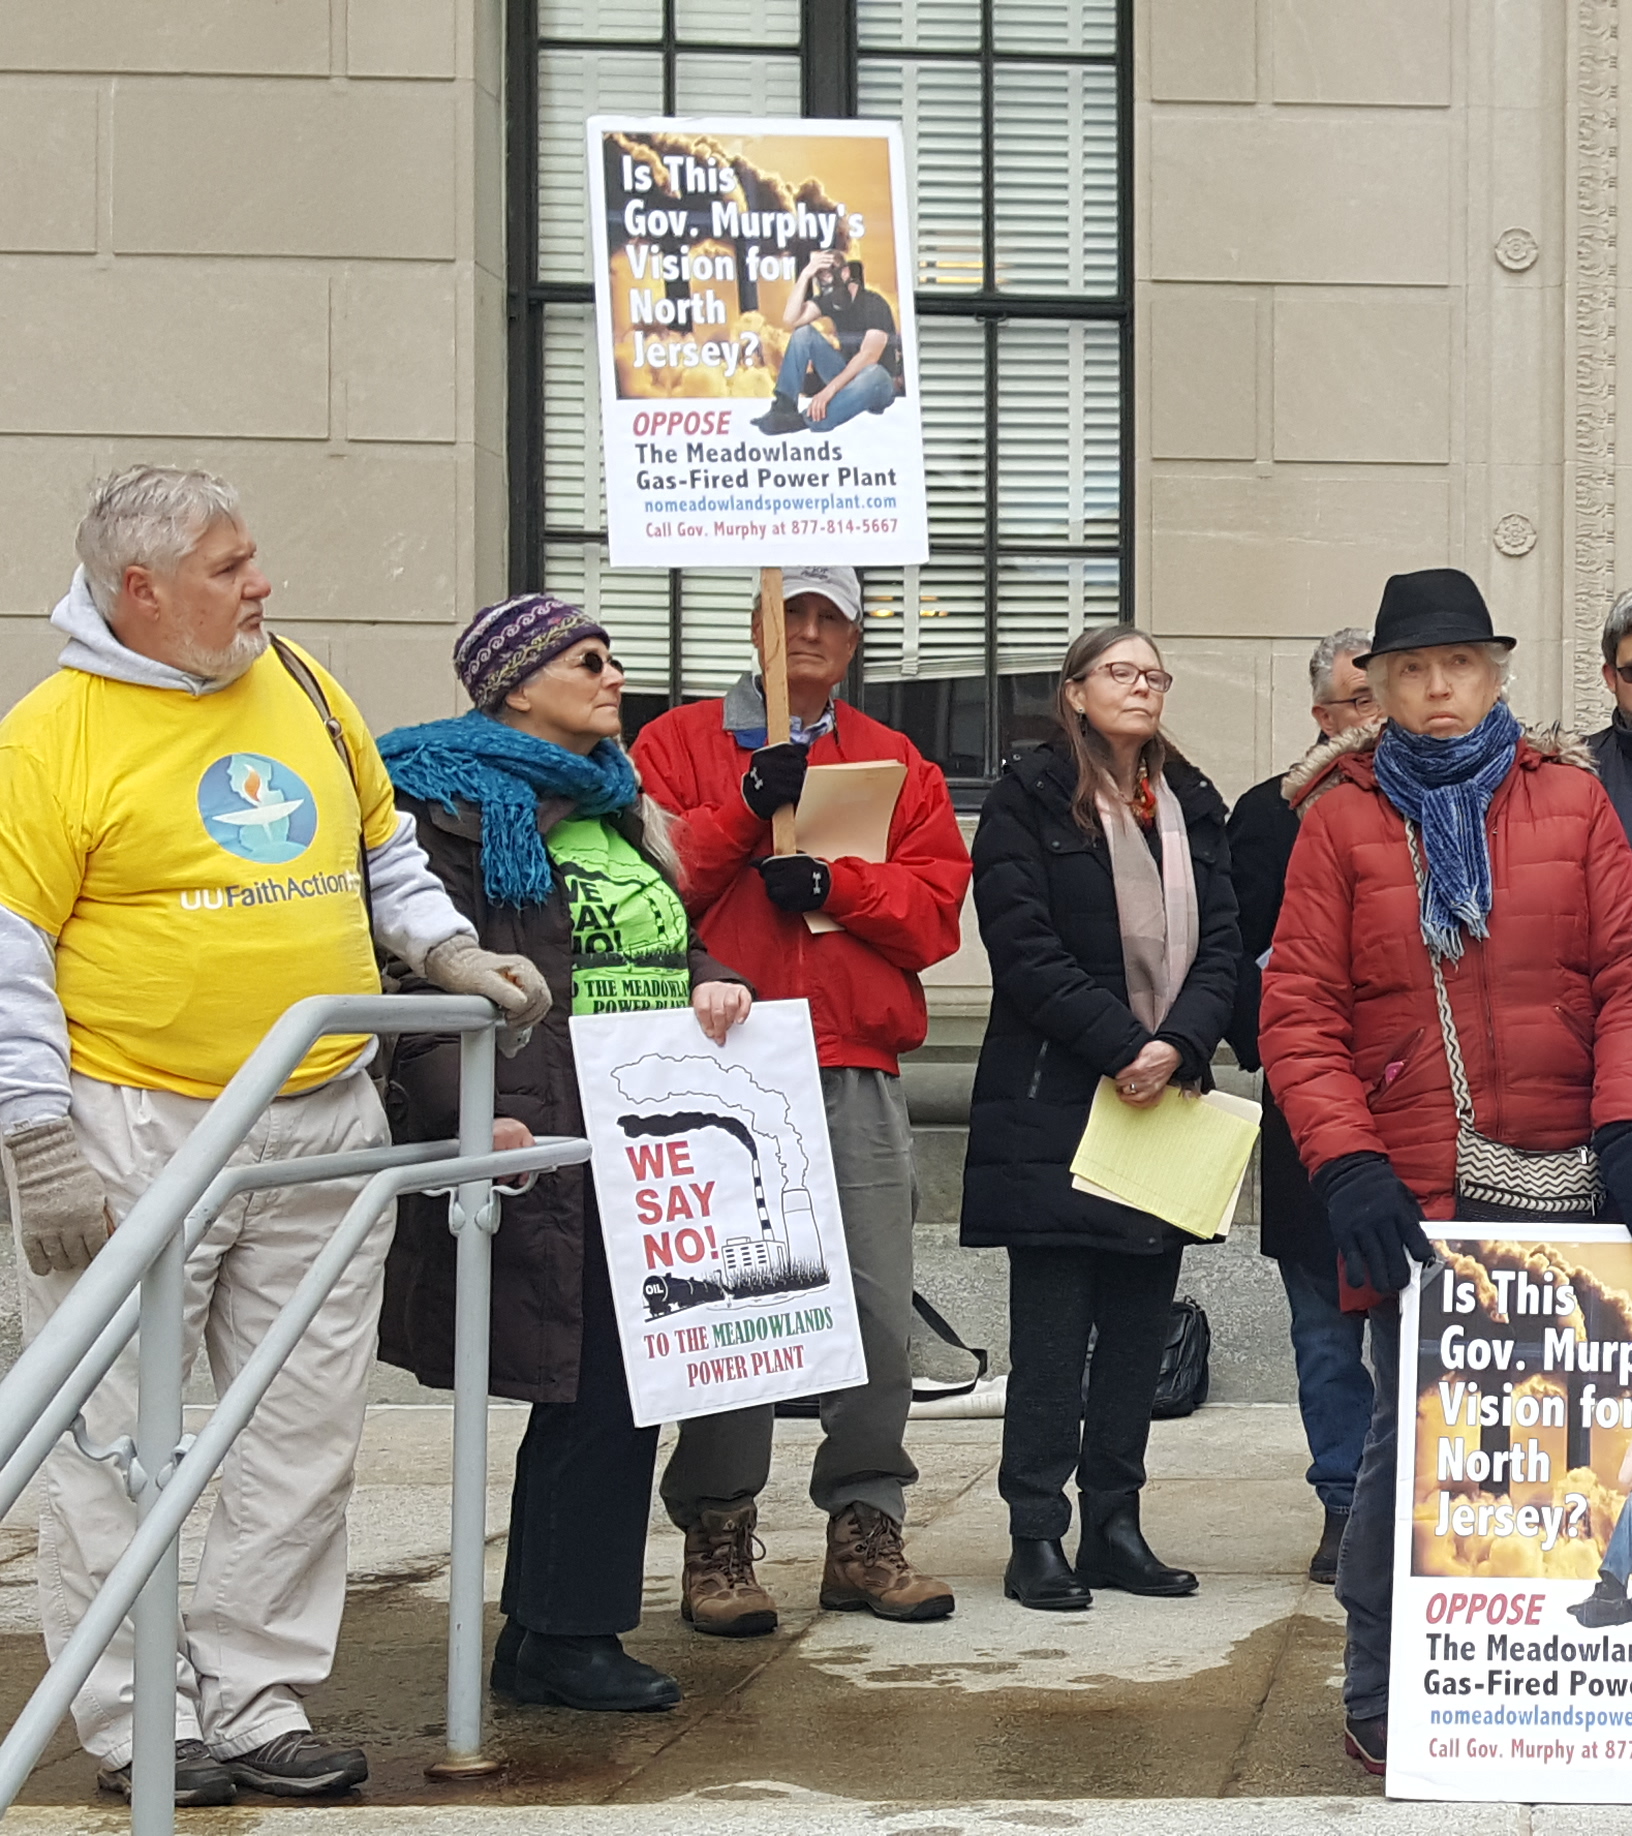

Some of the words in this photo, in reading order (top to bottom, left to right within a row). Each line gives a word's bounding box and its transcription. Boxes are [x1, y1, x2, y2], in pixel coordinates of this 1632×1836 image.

[621, 155, 652, 192] Is
[663, 155, 736, 194] This
[624, 199, 699, 238] Gov.
[711, 203, 865, 248] Murphy's
[626, 245, 735, 281] Vision
[746, 250, 796, 281] for
[629, 289, 726, 325] North
[633, 330, 759, 377] Jersey?
[633, 410, 732, 436] OPPOSE
[635, 443, 678, 464] The
[687, 440, 842, 463] Meadowlands
[636, 469, 748, 490] Gas-Fired
[758, 468, 830, 488] Power
[837, 467, 897, 486] Plant
[645, 494, 897, 515] nomeadowlandspowerplant.com
[645, 522, 672, 538] Call
[677, 521, 709, 537] Gov.
[714, 521, 767, 539] Murphy
[772, 523, 786, 535] at
[791, 518, 898, 535] 877-814-5667
[571, 904, 618, 932] AY
[584, 980, 617, 997] THE
[626, 1140, 695, 1182] WE
[637, 1181, 716, 1225] SAY
[643, 1224, 720, 1270] NO!
[645, 1284, 664, 1295] OIL
[1442, 1269, 1475, 1313] Is
[1491, 1270, 1576, 1317] This
[644, 1333, 670, 1359] TO
[675, 1326, 709, 1354] THE
[712, 1307, 833, 1348] MEADOWLANDS
[1440, 1327, 1526, 1371] Gov.
[687, 1356, 748, 1387] POWER
[751, 1345, 804, 1376] PLANT
[1439, 1382, 1564, 1427] Vision
[1437, 1436, 1550, 1483] North
[1434, 1490, 1587, 1551] Jersey?
[1426, 1593, 1545, 1626] OPPOSE
[1426, 1633, 1476, 1661] The
[1423, 1669, 1558, 1697] Gas-Fired
[1429, 1738, 1462, 1758] Call
[1467, 1740, 1505, 1759] Gov.
[1511, 1740, 1575, 1764] Murphy
[1581, 1742, 1599, 1760] at
